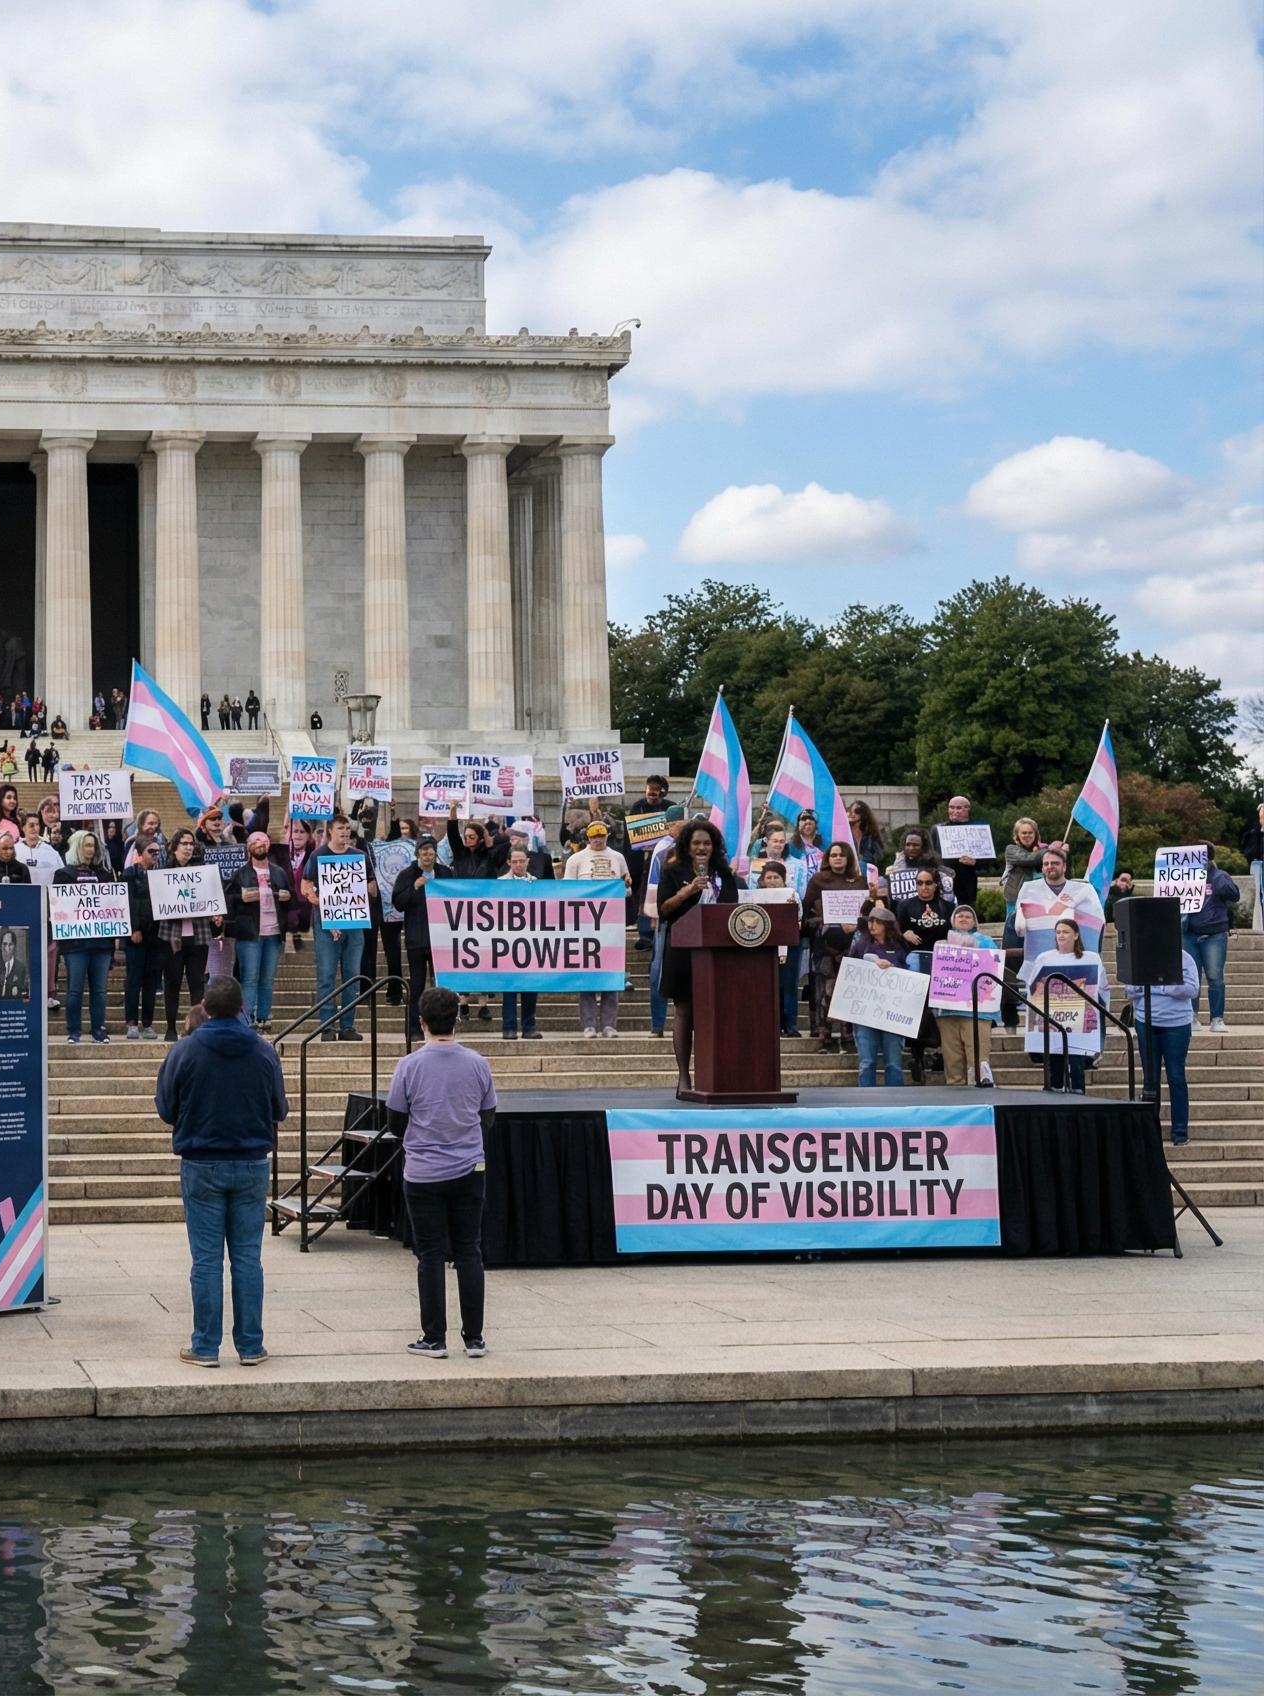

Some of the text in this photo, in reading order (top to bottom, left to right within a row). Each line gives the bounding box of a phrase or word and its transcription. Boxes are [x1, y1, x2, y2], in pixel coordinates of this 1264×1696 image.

[71, 773, 111, 787] TRANS
[1161, 851, 1208, 866] TRANS
[164, 871, 202, 885] TRANS
[1158, 867, 1206, 883] RIGHTS
[77, 897, 101, 908] ARE
[324, 907, 367, 920] RIGHTS
[443, 900, 607, 931] VISIBILITY
[452, 937, 601, 969] IS POWER
[658, 1131, 949, 1175] TRANSGENDER
[646, 1178, 964, 1220] DAY OF VISIBILITY
